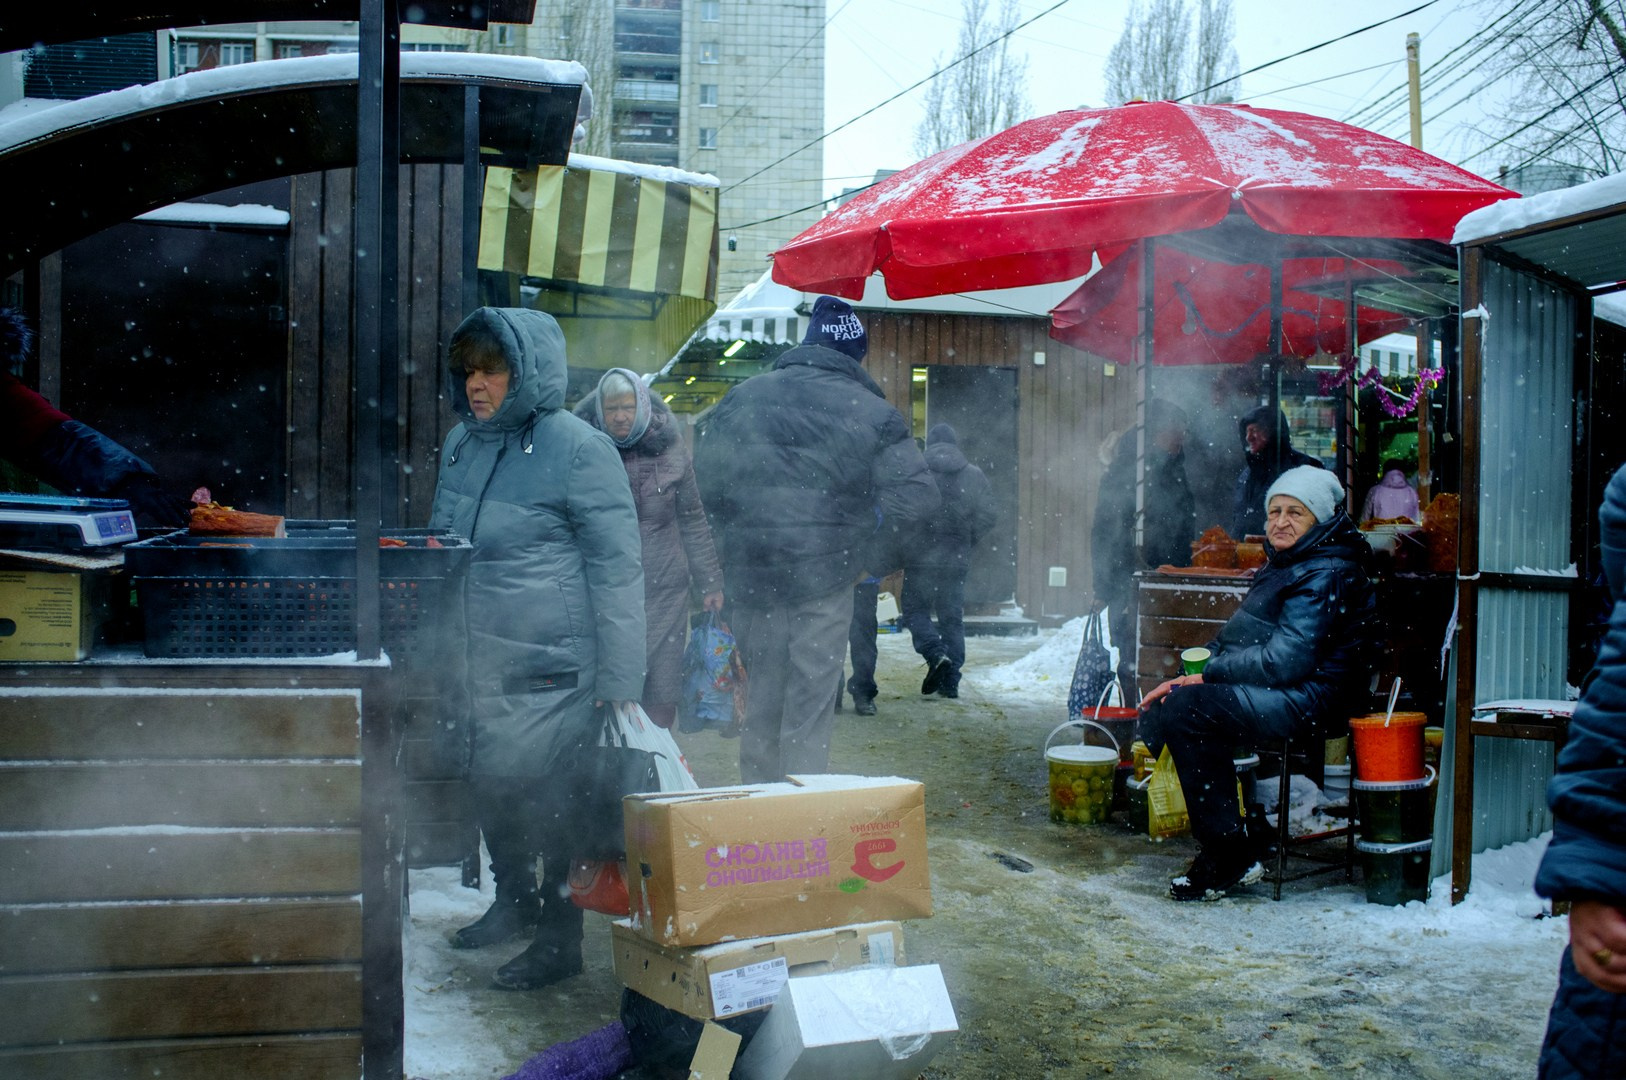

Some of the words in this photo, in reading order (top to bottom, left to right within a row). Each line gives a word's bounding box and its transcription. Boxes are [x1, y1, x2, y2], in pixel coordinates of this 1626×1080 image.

[838, 312, 857, 324] THE
[821, 322, 861, 333] NORTH
[850, 820, 900, 833] БОРОДИНА
[811, 837, 828, 860] &
[867, 841, 886, 851] 1997
[705, 840, 805, 868] ВКУСНО
[706, 860, 830, 887] НАТУРАЛЬНО
